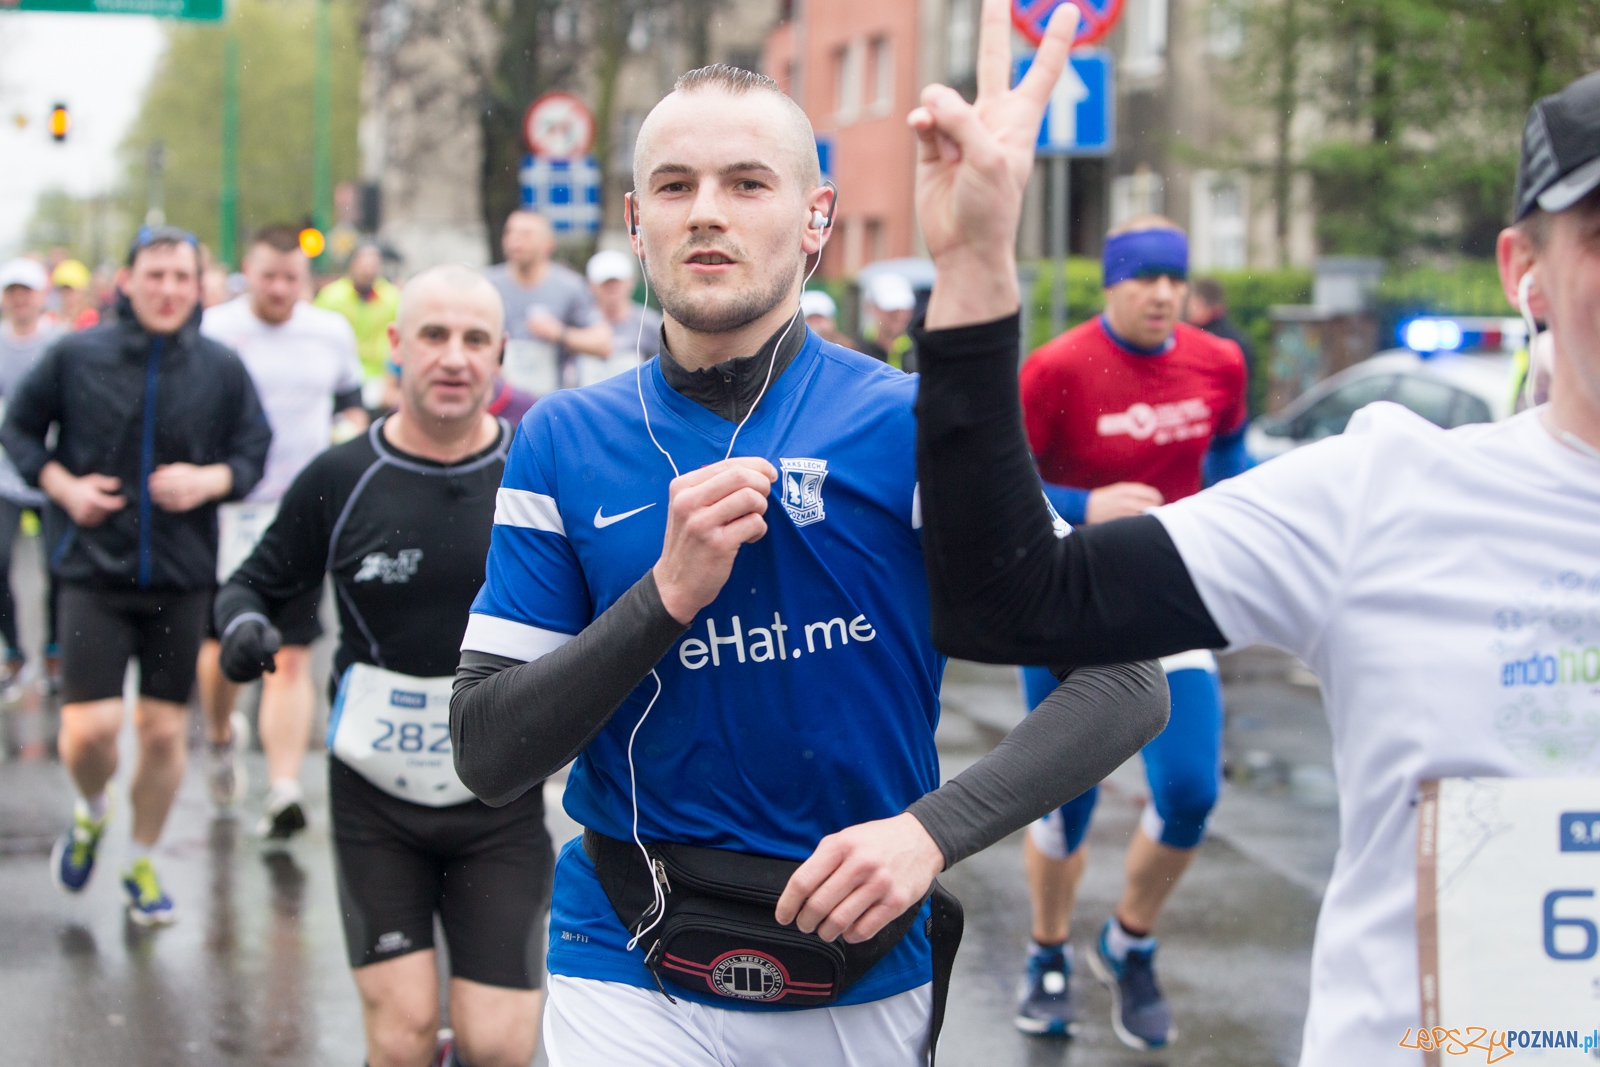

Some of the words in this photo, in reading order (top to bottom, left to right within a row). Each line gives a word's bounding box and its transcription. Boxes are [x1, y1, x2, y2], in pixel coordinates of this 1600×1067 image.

[679, 611, 877, 670] eHat.me
[1542, 889, 1599, 961] 6
[714, 970, 722, 980] PIT
[719, 957, 739, 970] BULL
[740, 956, 765, 965] WEST
[765, 963, 782, 983] COAST
